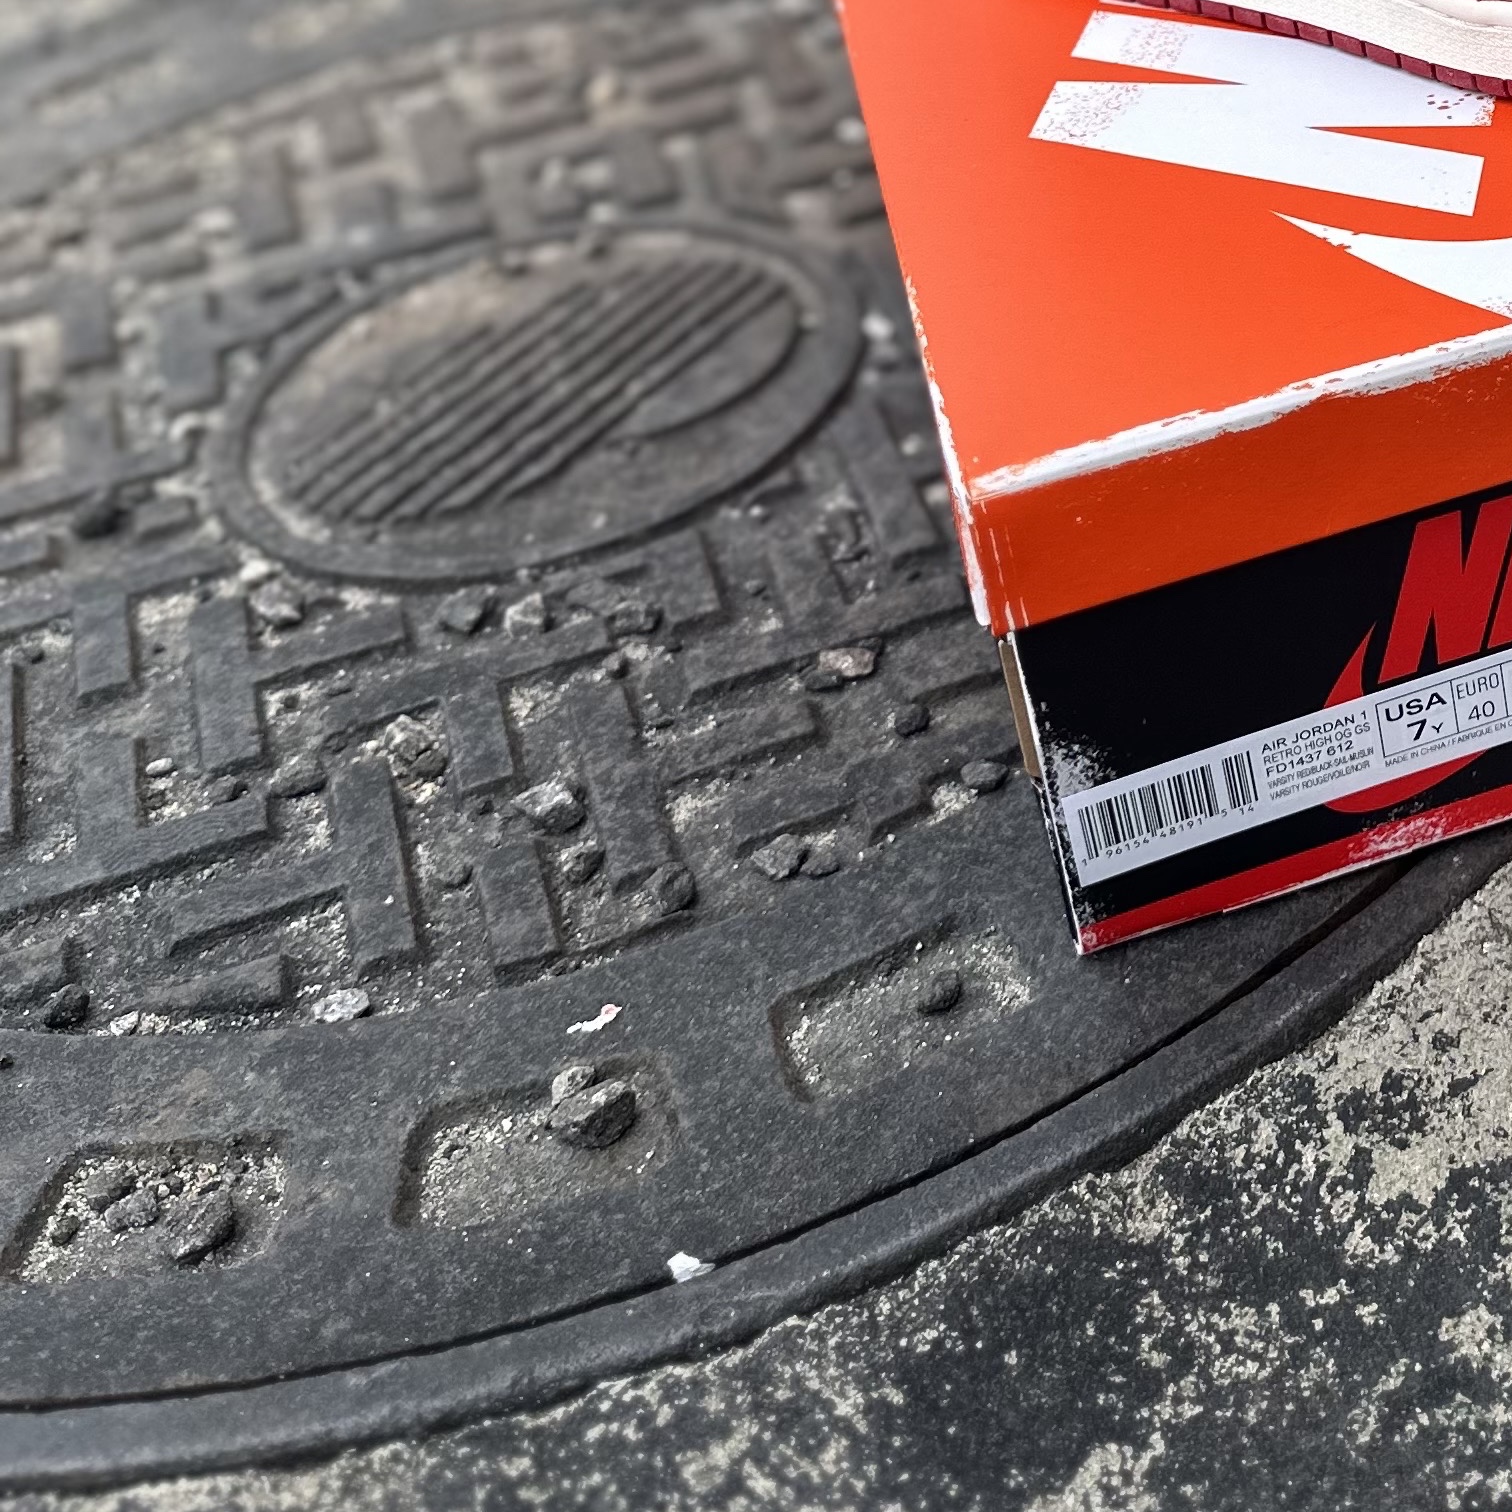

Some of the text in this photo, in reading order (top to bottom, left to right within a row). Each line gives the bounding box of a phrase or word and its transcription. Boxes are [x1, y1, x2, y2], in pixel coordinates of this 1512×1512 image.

[1455, 672, 1500, 700] EURO
[1384, 691, 1447, 722] USA
[1467, 700, 1495, 721] 40
[1261, 709, 1367, 755] AIR JORDAN 1
[1263, 721, 1371, 766] RETRO HIGH OG GS
[1384, 754, 1409, 768] MADE
[1410, 751, 1419, 759] IN
[1420, 741, 1446, 756] CHINA
[1451, 727, 1493, 746] FABRIQUE
[1494, 722, 1507, 732] EN
[1266, 739, 1354, 777] FD1437 612
[1267, 772, 1295, 789] VARSITY
[1269, 783, 1300, 800] VARSITY
